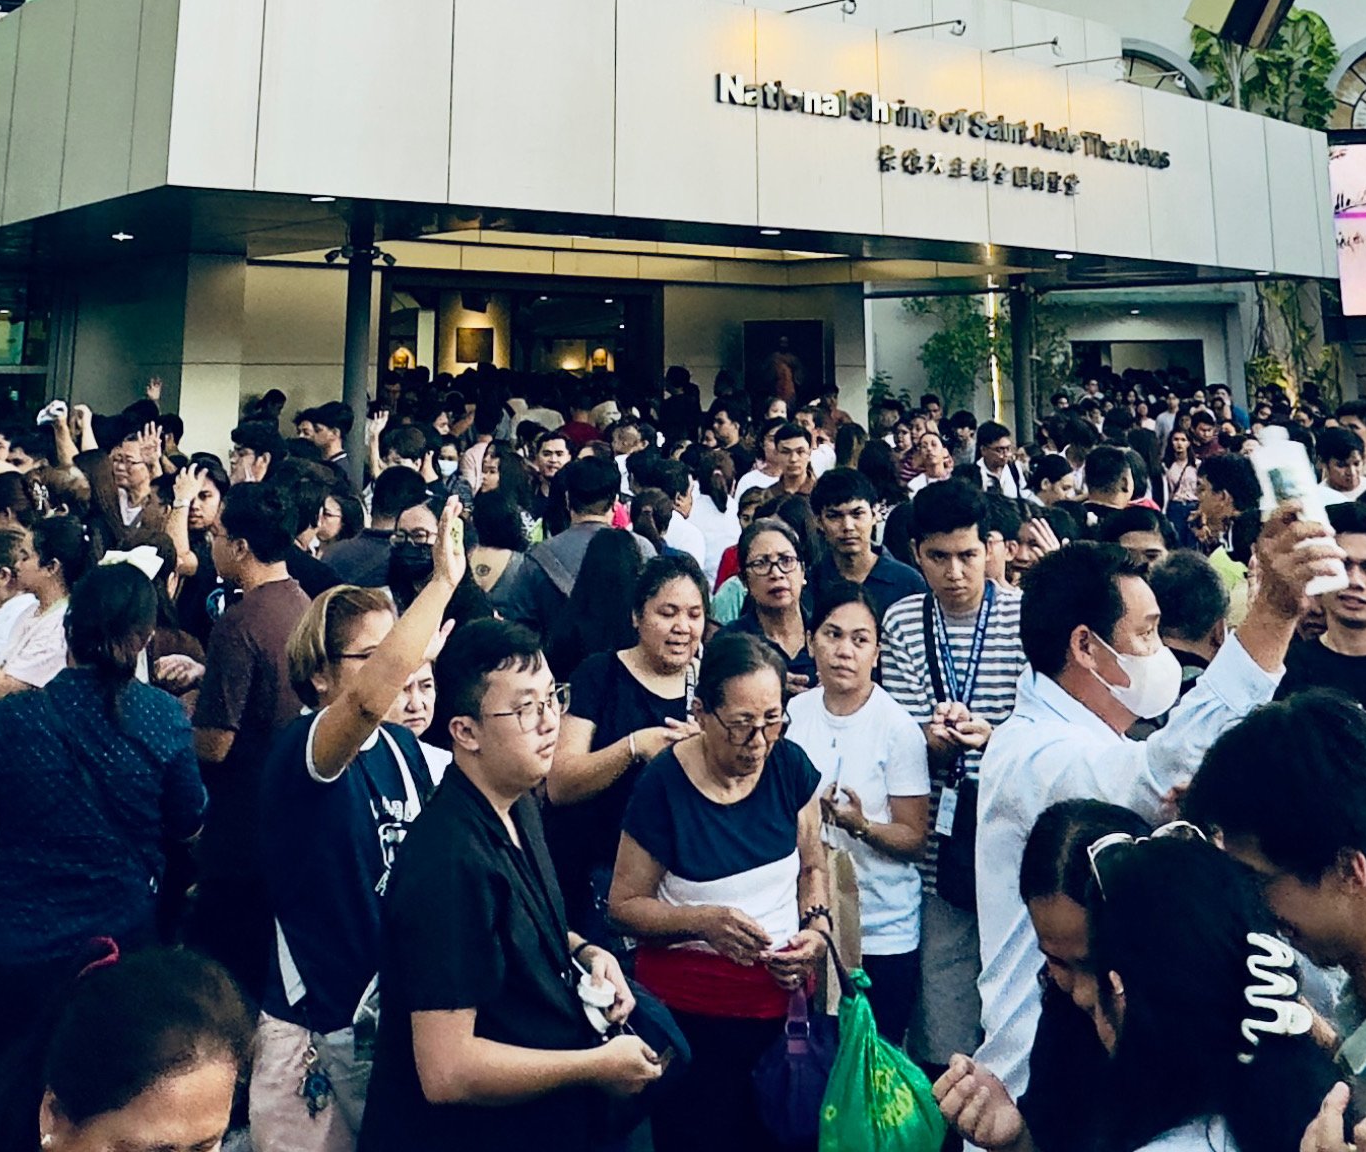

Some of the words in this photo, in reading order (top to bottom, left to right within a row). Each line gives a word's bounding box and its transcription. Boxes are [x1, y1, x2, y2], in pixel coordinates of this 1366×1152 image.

[716, 72, 846, 118] National
[848, 91, 937, 131] Shrine
[938, 108, 967, 136] of
[968, 111, 1029, 145] Saint
[1029, 122, 1082, 155] Jude
